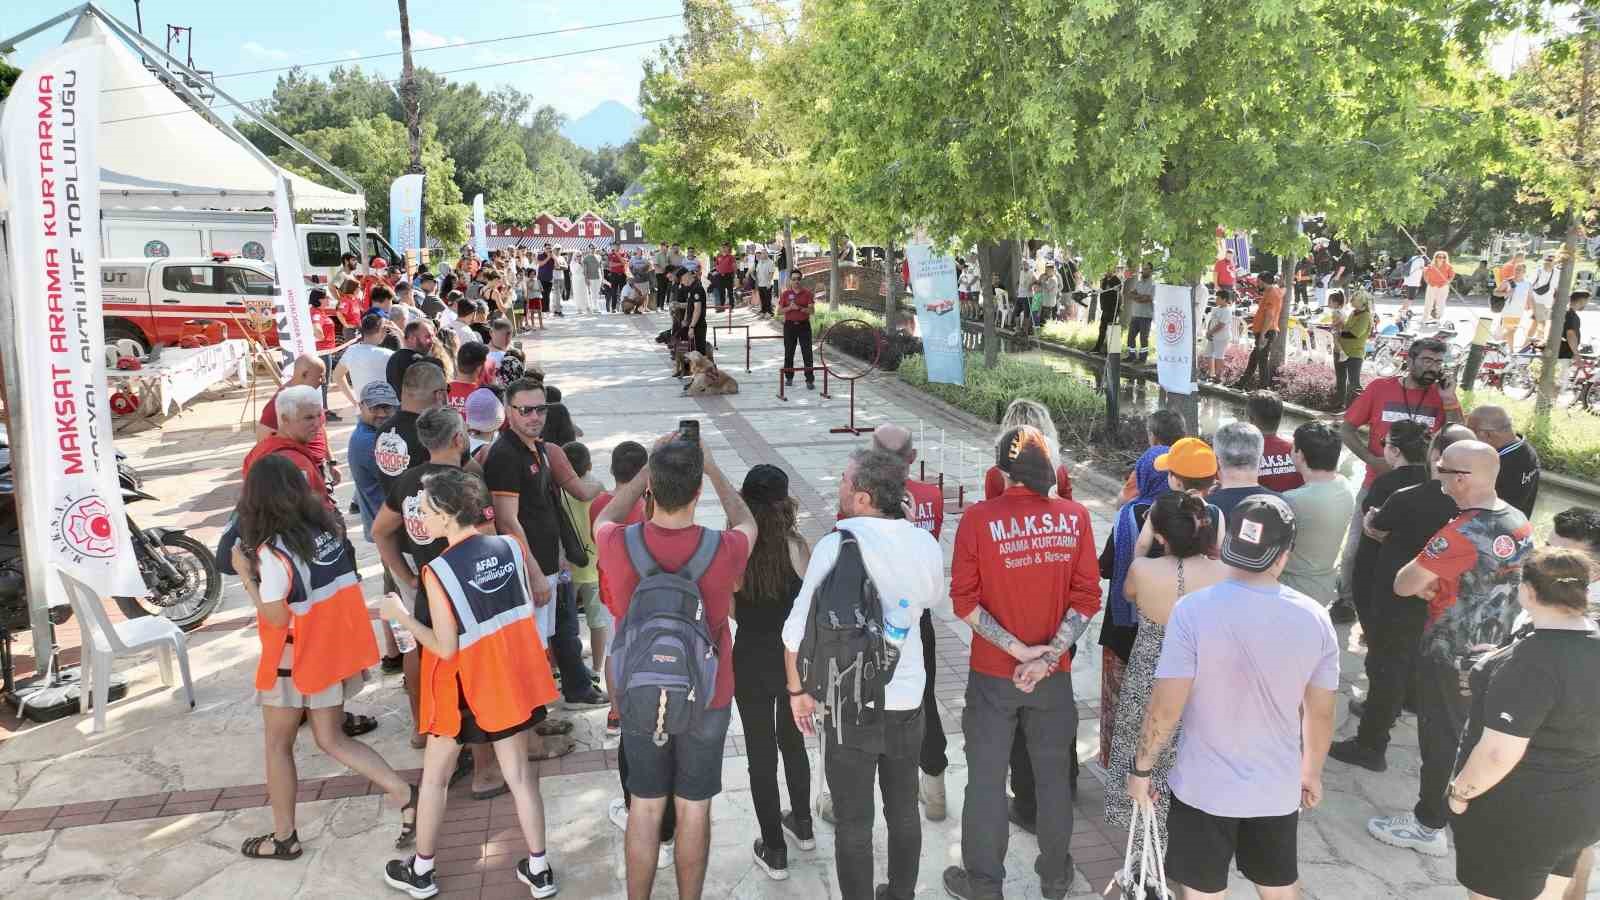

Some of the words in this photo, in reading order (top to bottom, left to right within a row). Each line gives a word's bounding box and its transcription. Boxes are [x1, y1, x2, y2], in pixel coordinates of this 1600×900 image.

[38, 74, 57, 237] KURTARMA
[45, 248, 68, 353] ARAMA
[51, 364, 84, 475] MAKSAT
[989, 513, 1080, 542] M.A.K.S.A.T.
[999, 539, 1029, 555] ARAMA
[1031, 535, 1077, 550] KURTARMA
[475, 556, 499, 572] AFAD
[1005, 554, 1033, 569] Search
[1034, 552, 1042, 564] &
